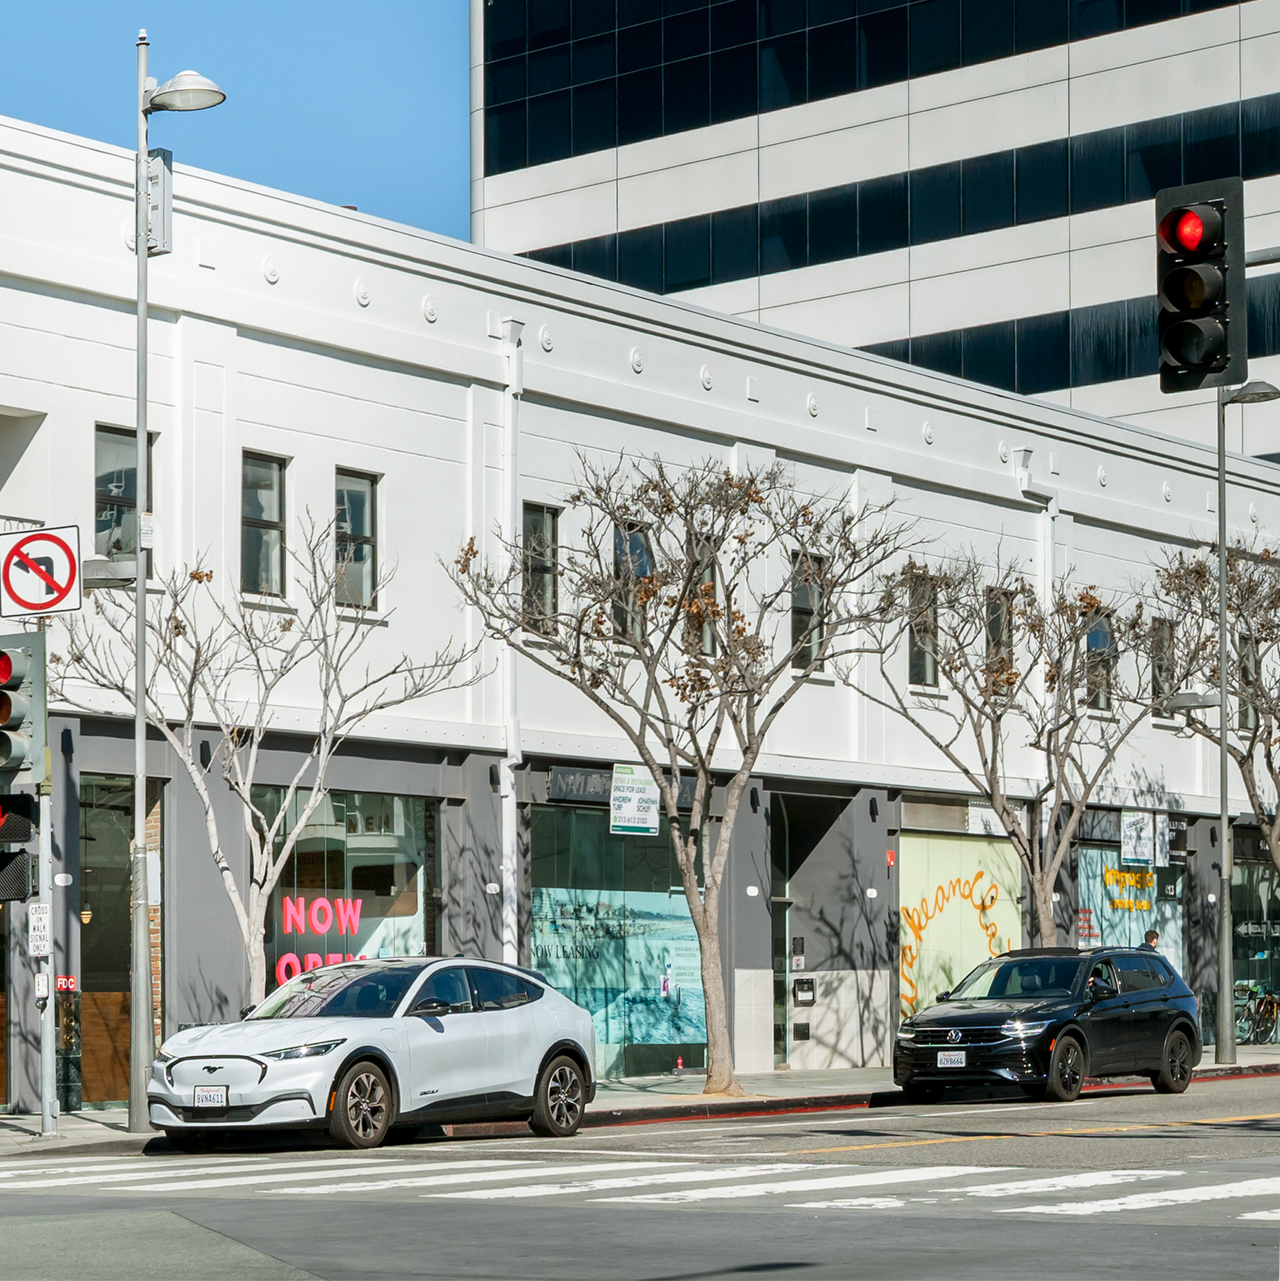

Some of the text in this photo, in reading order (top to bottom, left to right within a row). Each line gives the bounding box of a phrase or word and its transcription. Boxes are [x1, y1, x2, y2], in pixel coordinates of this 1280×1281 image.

[31, 906, 48, 915] CROSS
[282, 896, 363, 935] NOW
[32, 924, 46, 933] WALK
[30, 935, 49, 943] SIGNAL
[32, 944, 46, 953] ONLY
[530, 944, 600, 959] NOW LEASING
[57, 977, 75, 989] FDC
